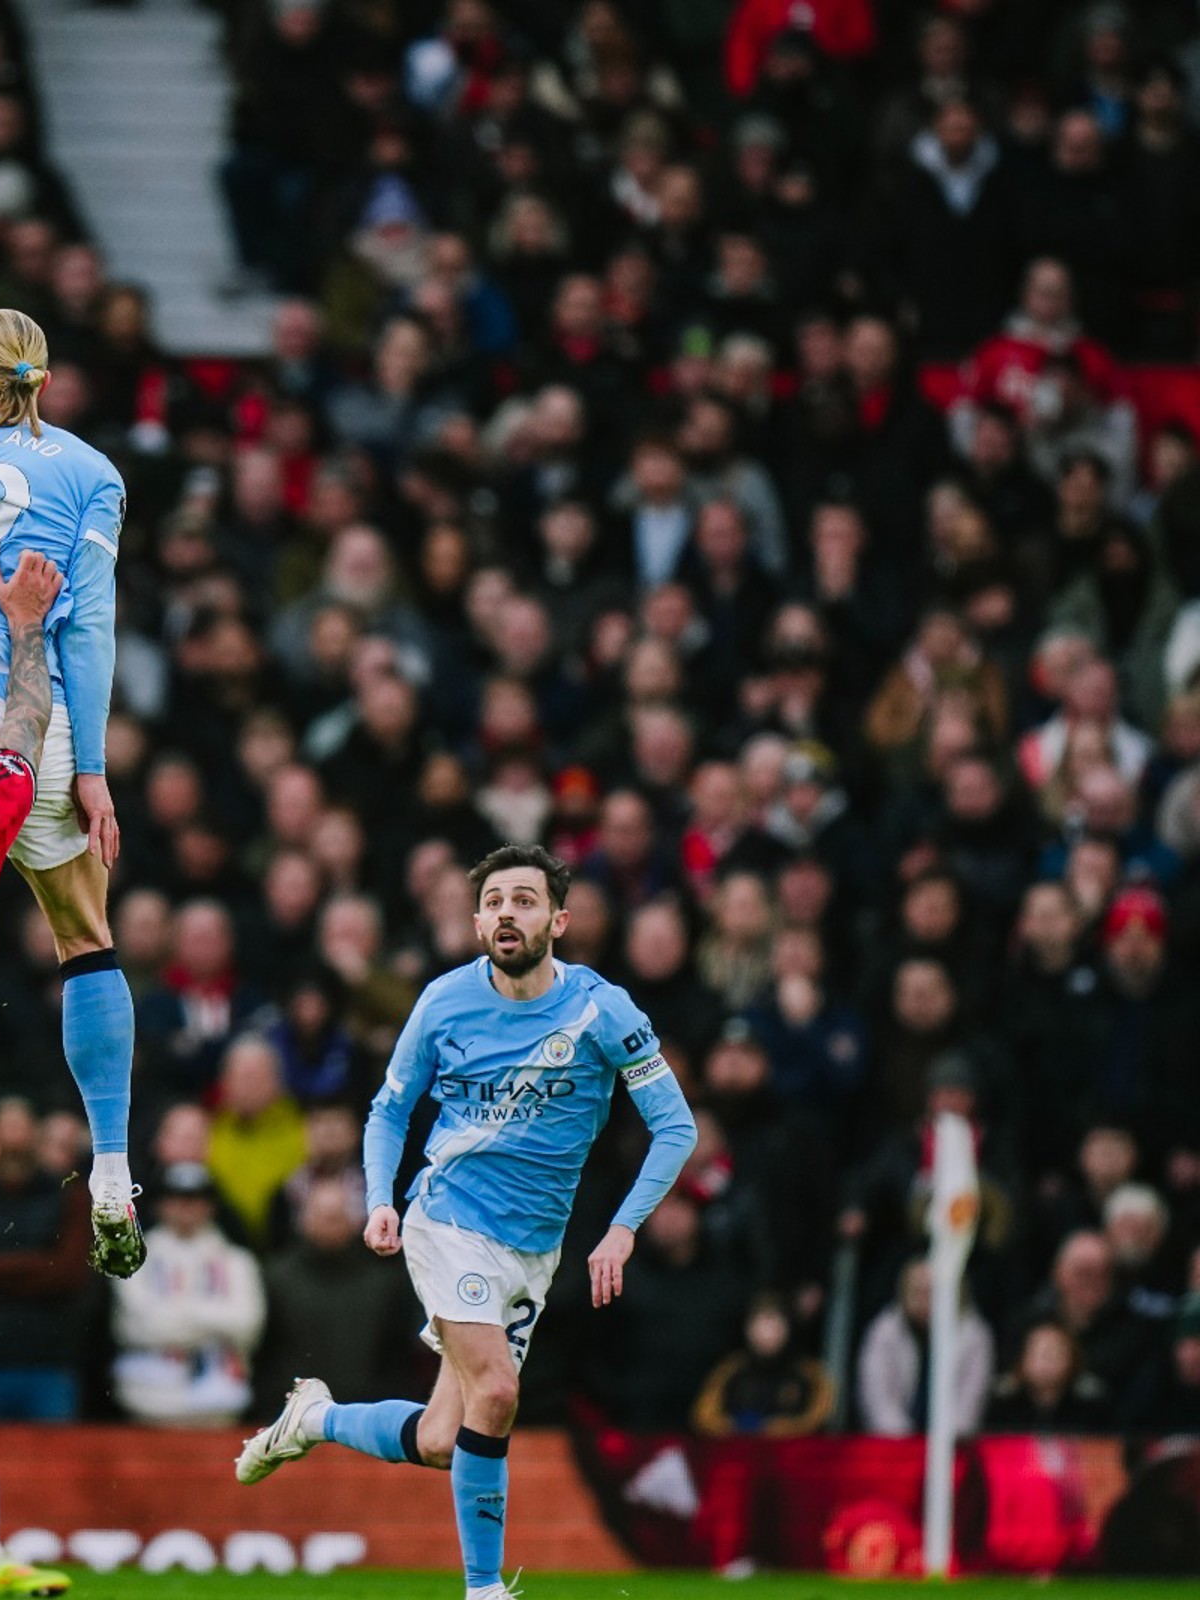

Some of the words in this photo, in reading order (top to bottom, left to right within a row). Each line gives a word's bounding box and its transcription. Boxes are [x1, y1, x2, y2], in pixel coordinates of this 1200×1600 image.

[622, 1021, 655, 1055] OK
[440, 1077, 577, 1102] ETIHAD
[462, 1104, 544, 1122] AIRWAYS
[505, 1298, 537, 1348] 2
